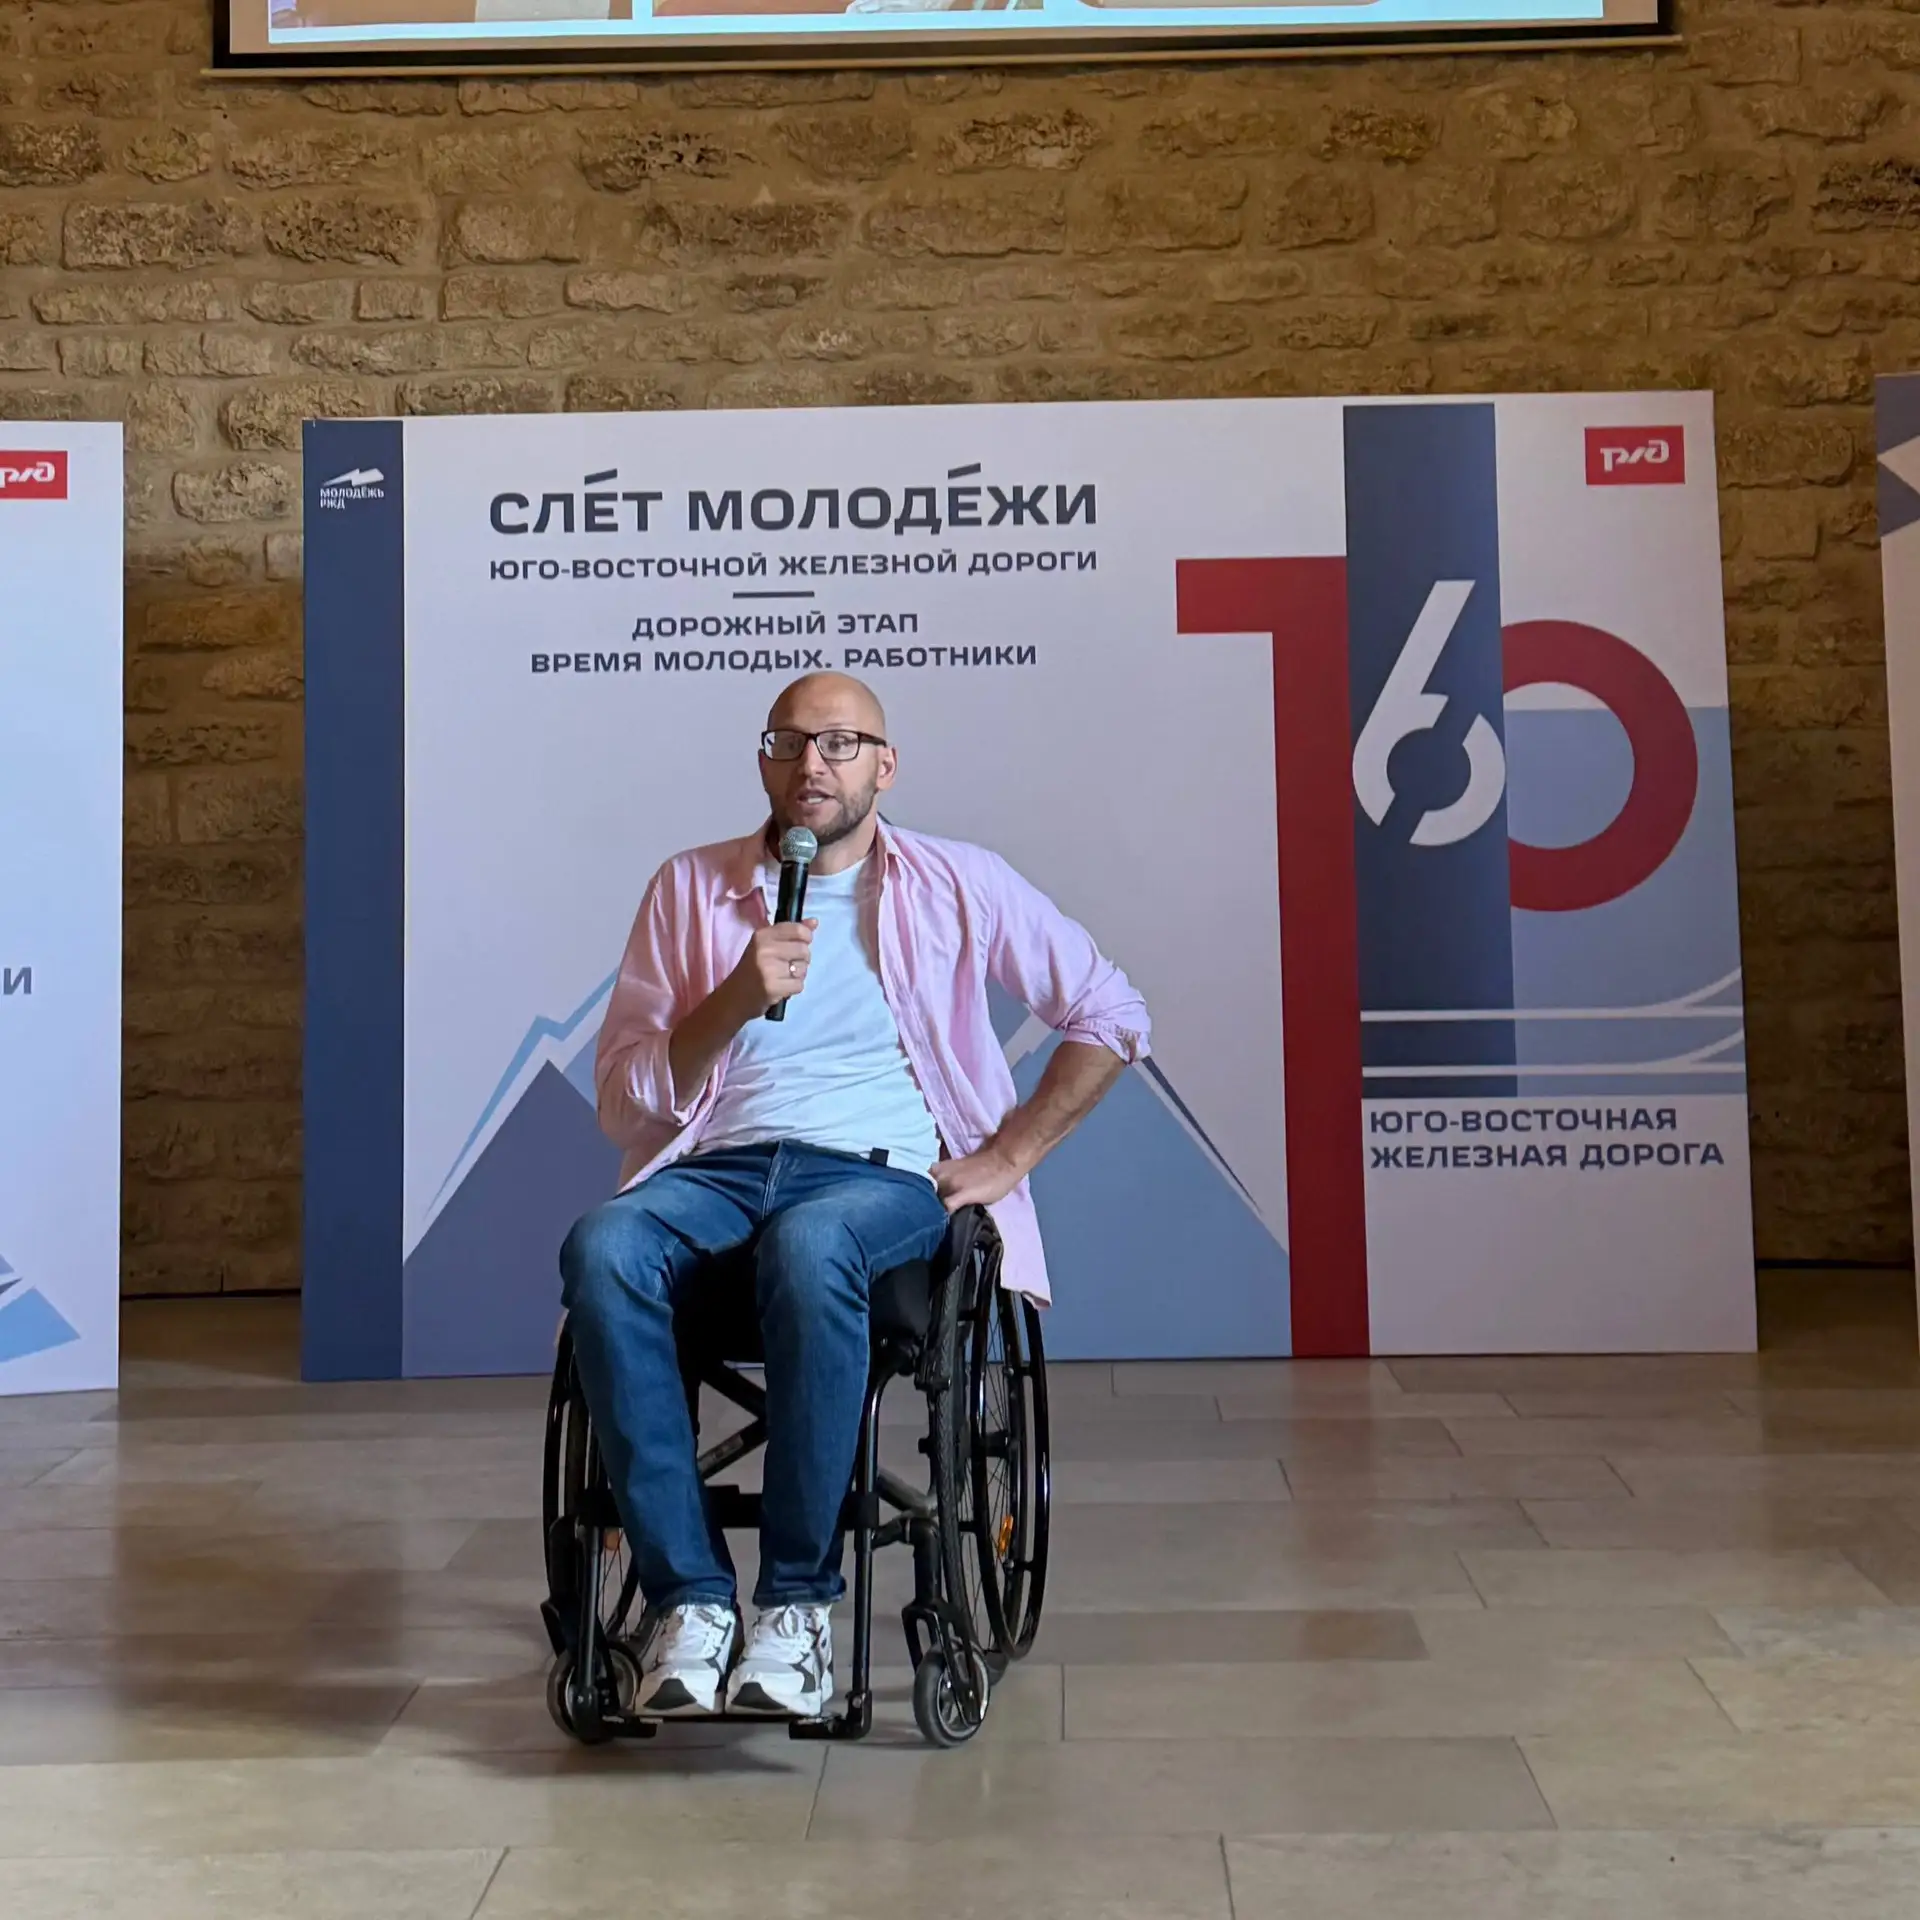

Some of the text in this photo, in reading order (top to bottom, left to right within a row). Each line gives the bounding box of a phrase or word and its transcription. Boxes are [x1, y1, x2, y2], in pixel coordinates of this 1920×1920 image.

[490, 548, 1097, 580] ЮГО-ВОСТОЧНОЙ ЖЕЛЕЗНОЙ ДОРОГИ
[631, 610, 918, 641] ДОРОЖНЫЙ ЭТАП
[531, 645, 1037, 674] ВРЕМЯ МОЛОДЫХ. РАБОТНИКИ
[1370, 1107, 1677, 1134] ЮГО-ВОСТОЧНАЯ
[1370, 1142, 1725, 1170] ЖЕЛЕЗНАЯ ДОРОГА
